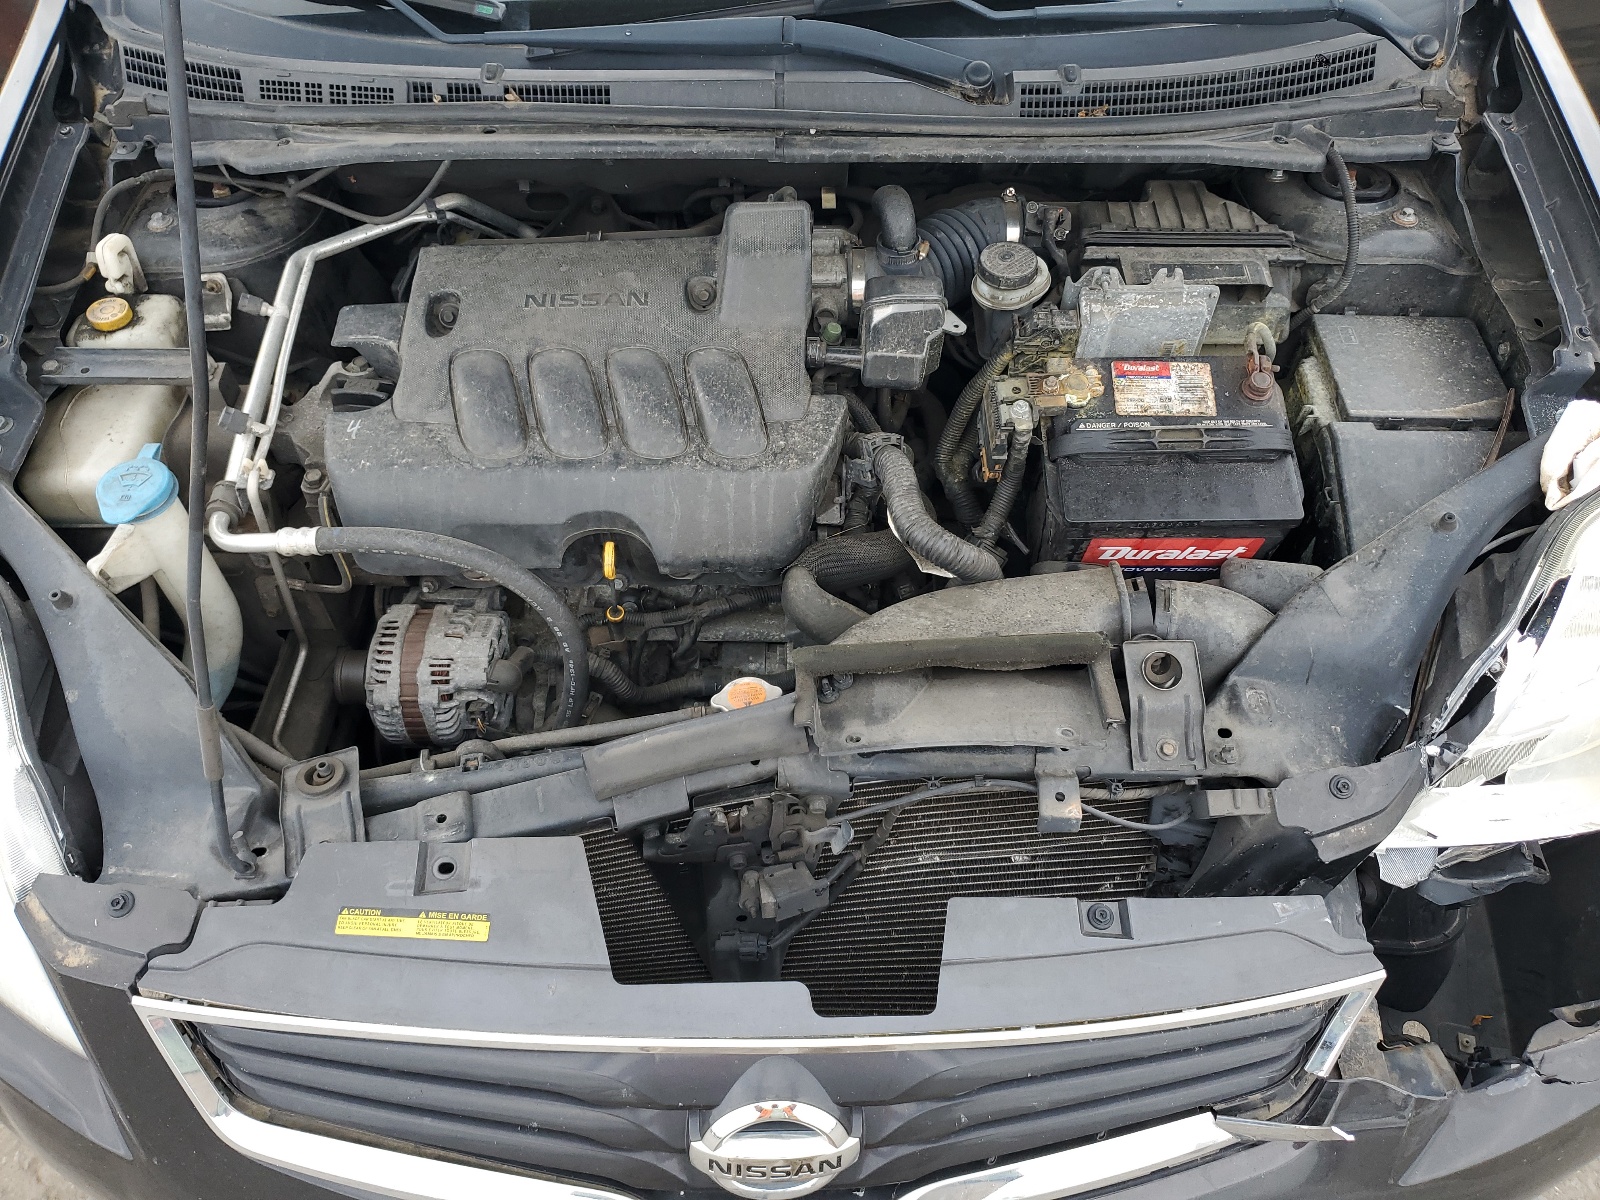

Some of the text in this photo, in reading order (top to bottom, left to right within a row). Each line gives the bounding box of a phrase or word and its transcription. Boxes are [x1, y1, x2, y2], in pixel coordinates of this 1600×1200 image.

[523, 292, 650, 309] NISSAN
[1120, 363, 1160, 372] Duralast
[347, 419, 361, 439] 4
[1097, 546, 1249, 560] Duralast
[448, 912, 460, 920] EN
[460, 913, 488, 921] GARDE
[708, 1154, 842, 1178] NISSAN
